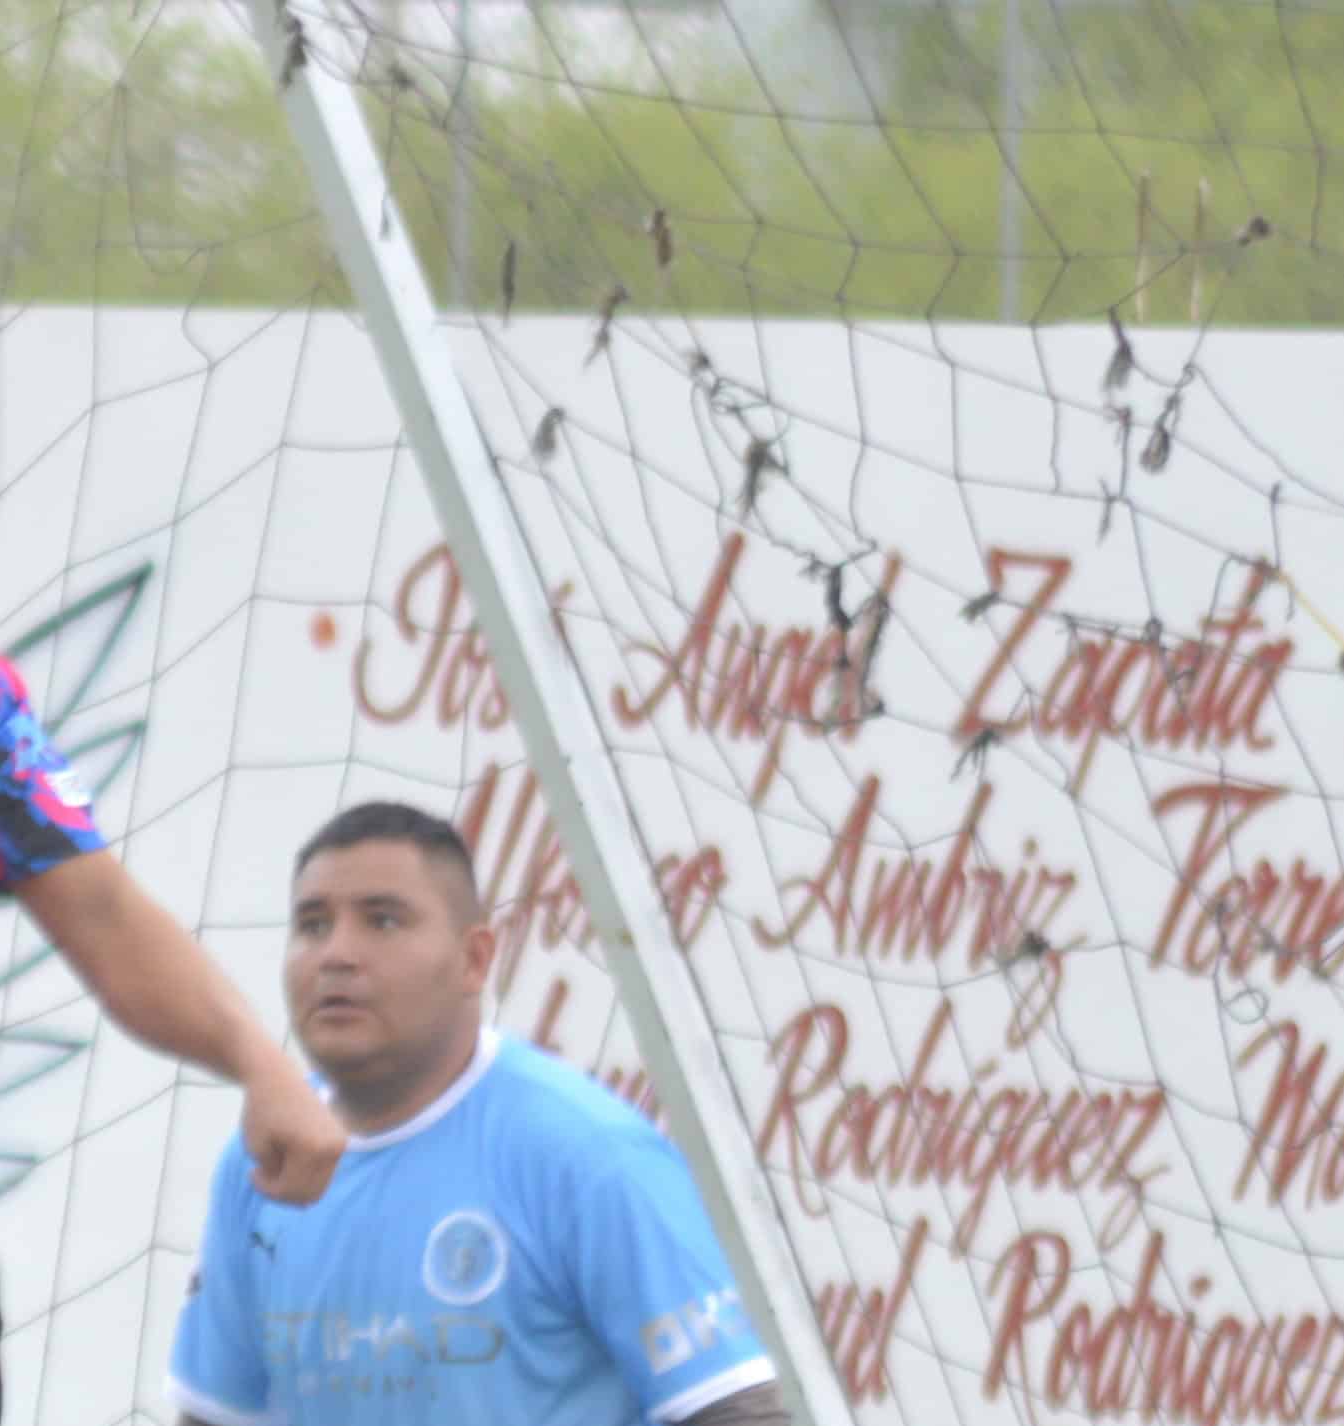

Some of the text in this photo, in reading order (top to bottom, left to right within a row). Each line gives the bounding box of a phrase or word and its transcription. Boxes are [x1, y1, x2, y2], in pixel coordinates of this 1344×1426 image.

[954, 547, 1294, 797] Zapata
[752, 775, 1089, 1050] Ambriz
[758, 1001, 1171, 1258] Rodríguez
